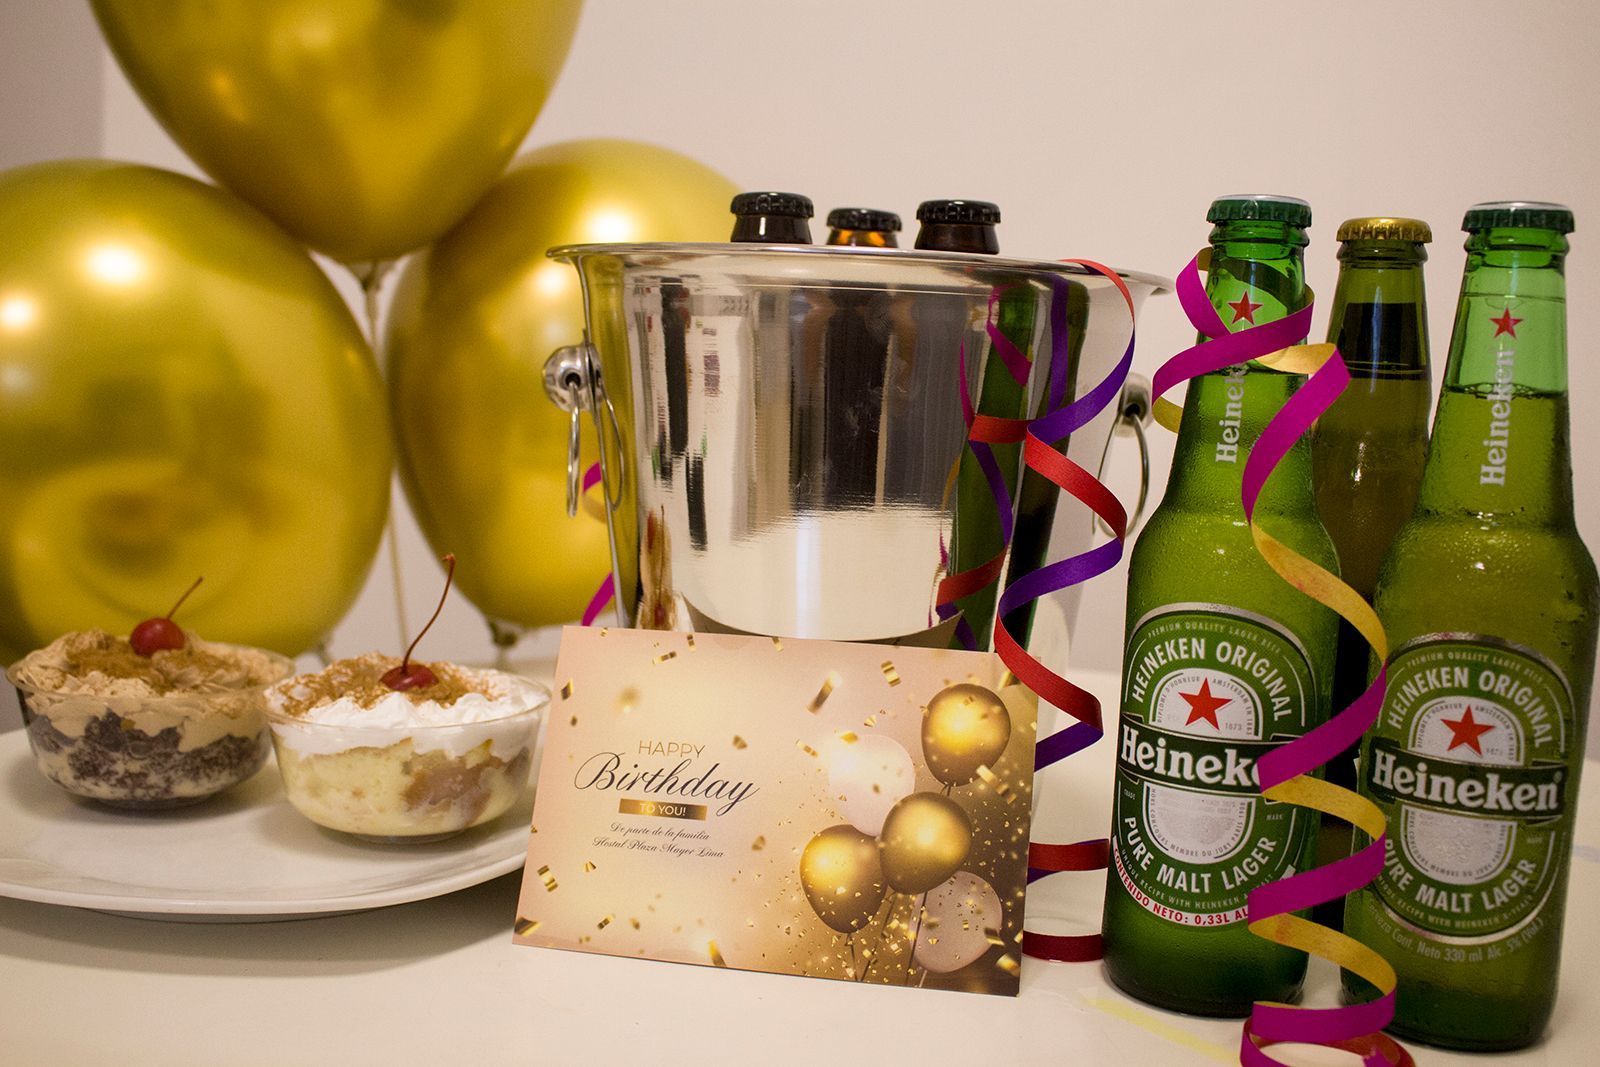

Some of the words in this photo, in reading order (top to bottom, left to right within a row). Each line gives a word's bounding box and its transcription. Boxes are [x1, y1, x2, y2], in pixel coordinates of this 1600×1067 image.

[1215, 366, 1244, 464] Heinek
[1480, 351, 1514, 486] Heineken
[1185, 621, 1225, 633] QUALITY
[1447, 651, 1489, 663] QUALITY
[1131, 637, 1207, 704] HEINEKEN
[1215, 641, 1293, 721] ORIGINAL
[1387, 666, 1470, 730] HEINEKEN
[1478, 670, 1553, 748] ORIGINAL
[637, 739, 706, 758] HAPPY
[1121, 723, 1261, 787] Heinek
[574, 751, 761, 816] Birthday
[640, 803, 656, 814] TO
[658, 805, 687, 817] YOU!
[1372, 748, 1560, 812] Heineken
[591, 836, 627, 850] Hostal
[627, 839, 659, 852] Plaza
[659, 843, 696, 858] Mayor
[696, 847, 726, 858] Lima
[651, 826, 664, 836] de
[664, 827, 676, 837] la
[1124, 817, 1155, 872] PURE
[1155, 863, 1212, 895] MALT
[1220, 836, 1277, 891] LAGER
[1112, 845, 1150, 907] CONTENIDO
[1152, 903, 1190, 924] NETO:
[1194, 911, 1231, 925] 0,33L
[1140, 878, 1166, 901] RECIPE
[1168, 894, 1191, 909] WITH
[1194, 896, 1240, 911] HEINEKEN
[1414, 884, 1473, 914] MALT
[1480, 858, 1537, 911] LAGER
[1416, 940, 1441, 962] Neto
[1442, 948, 1465, 963] 330
[1468, 947, 1483, 962] ml
